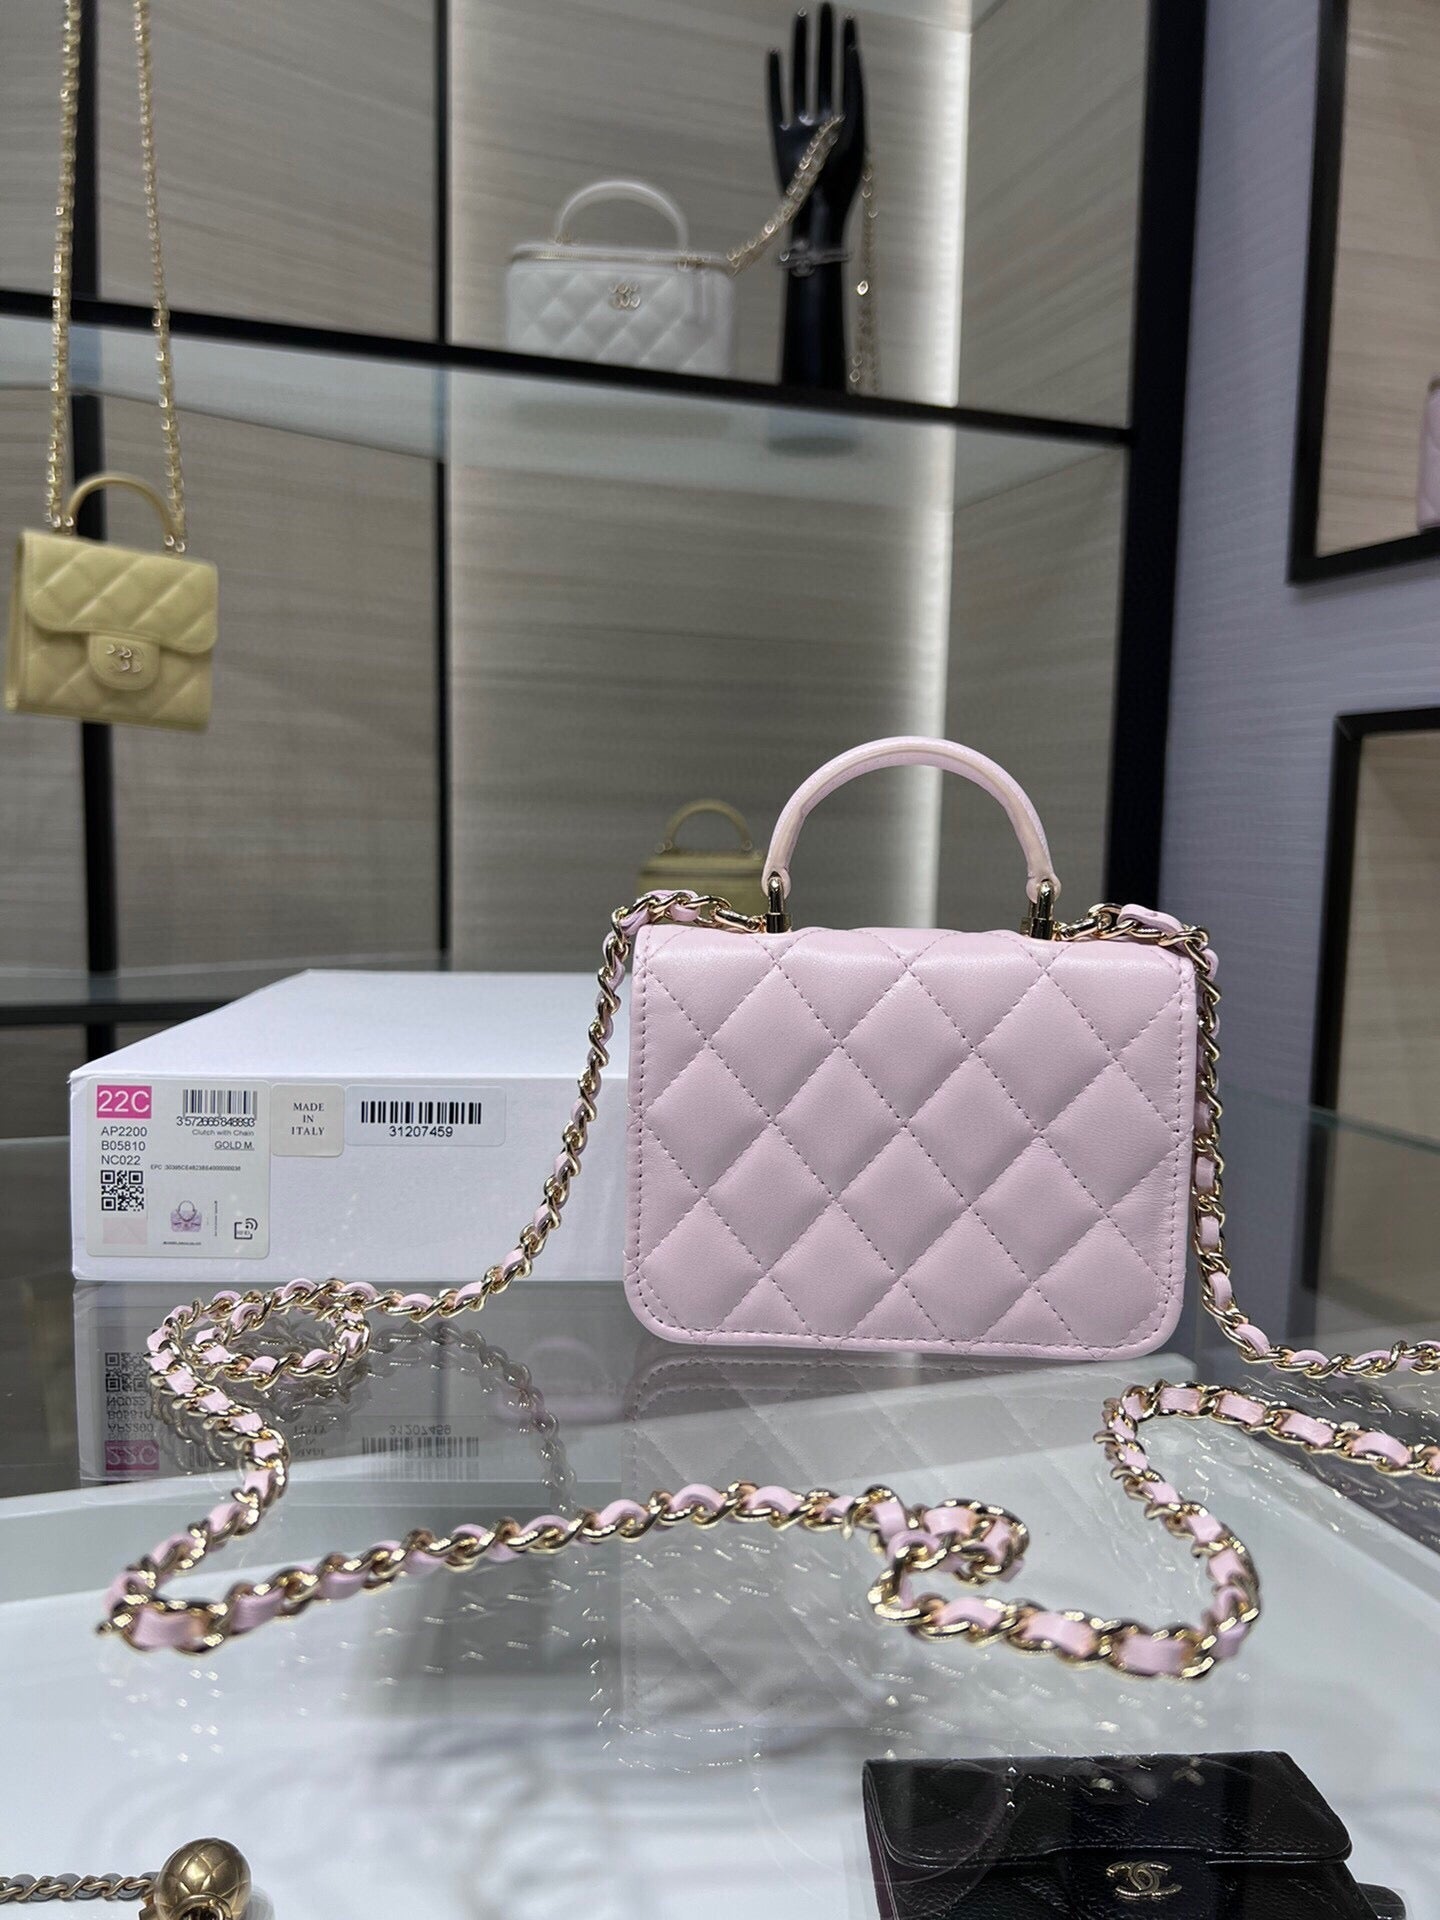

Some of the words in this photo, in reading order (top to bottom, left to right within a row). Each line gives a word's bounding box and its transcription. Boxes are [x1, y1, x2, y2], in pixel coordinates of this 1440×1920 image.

[98, 1090, 150, 1112] 22C
[293, 1102, 325, 1112] MADE
[303, 1114, 314, 1123] IN
[101, 1126, 148, 1137] AP2200
[192, 1128, 215, 1136] Clutch
[291, 1126, 325, 1136] ITALY
[389, 1125, 453, 1137] 31207459
[101, 1140, 146, 1151] B05810
[214, 1140, 242, 1150] GOLD
[101, 1154, 141, 1166] NC022
